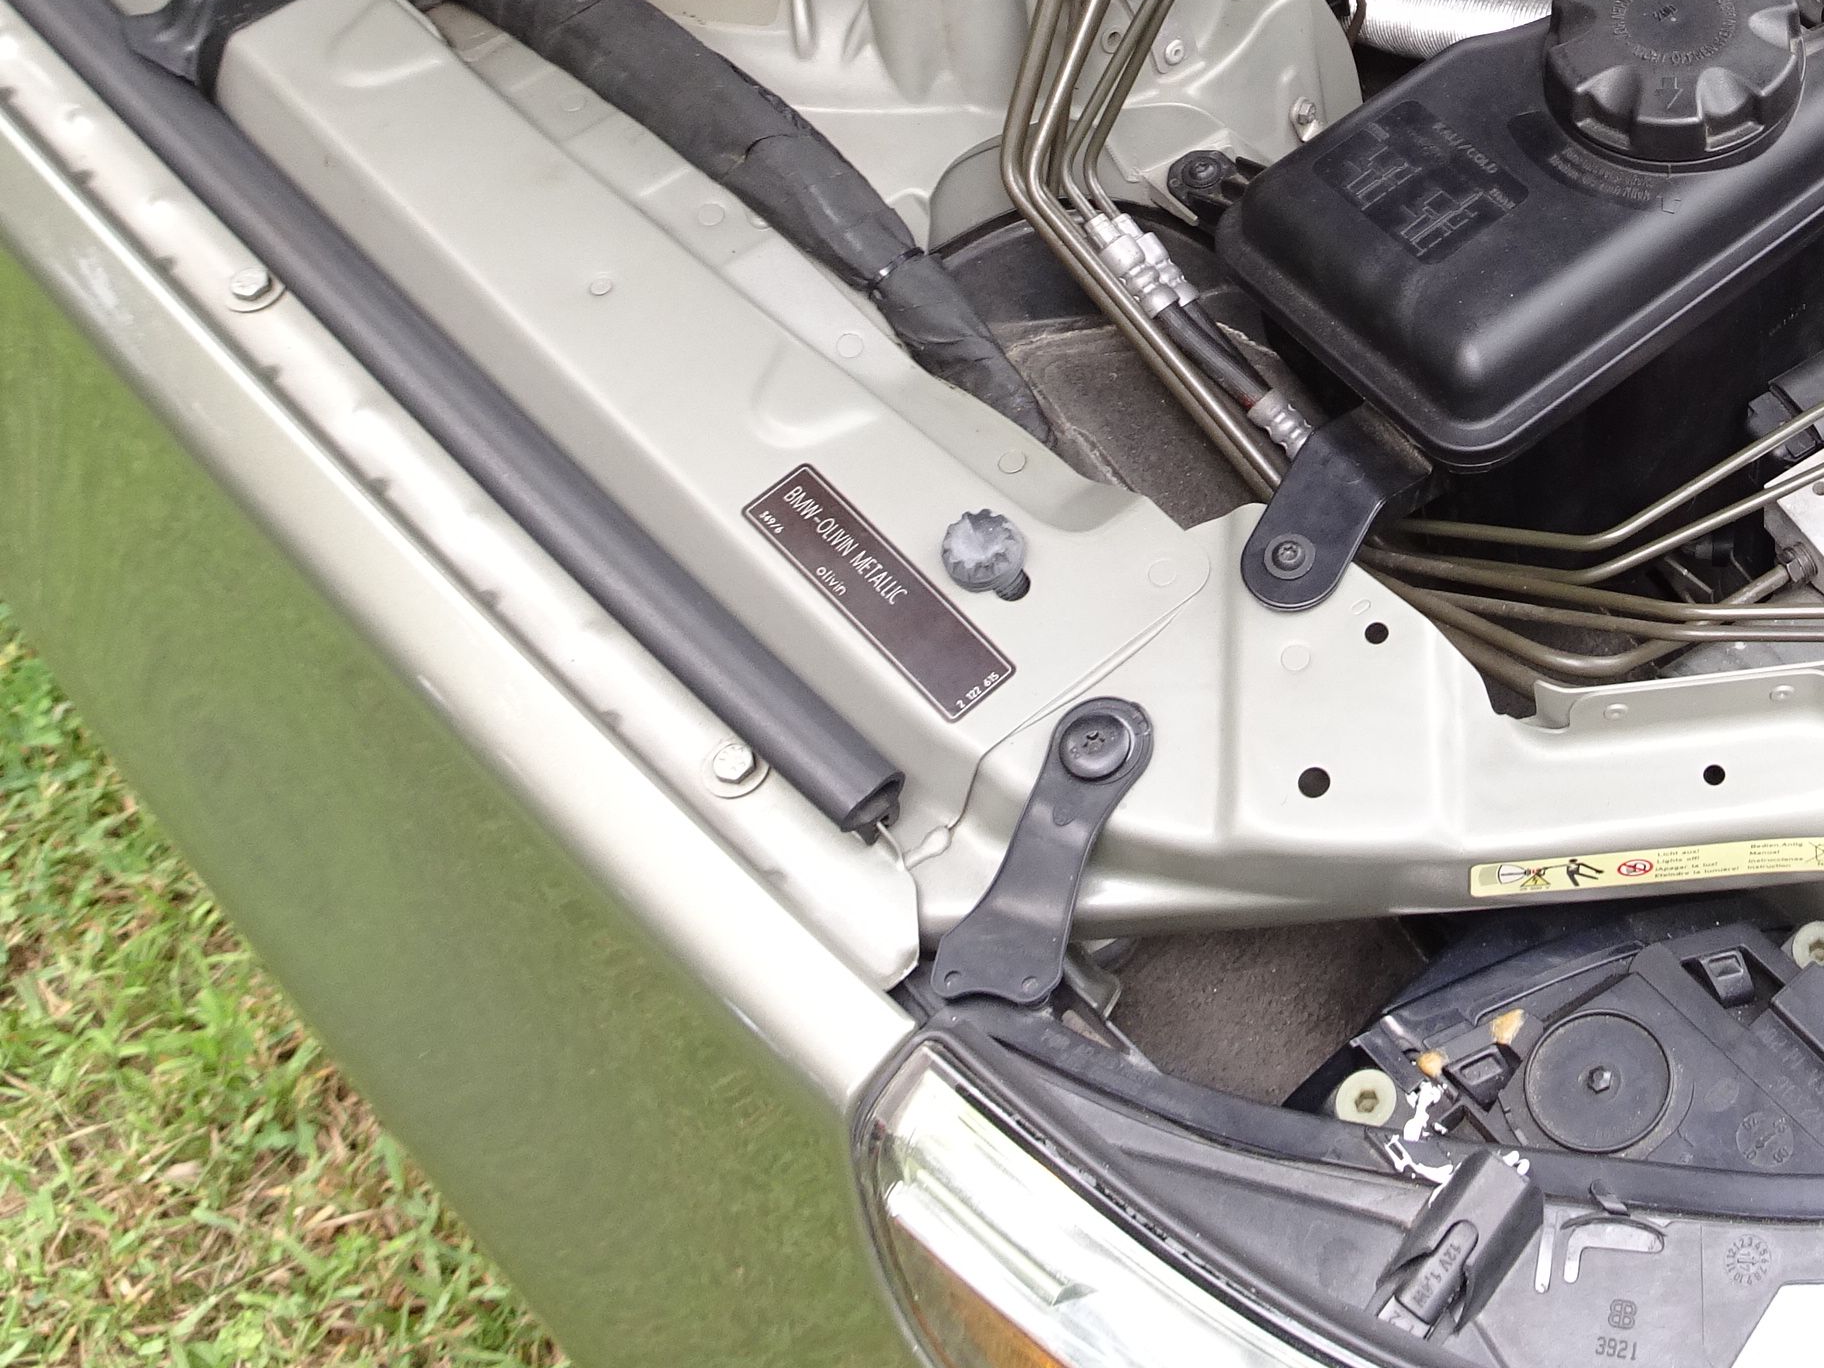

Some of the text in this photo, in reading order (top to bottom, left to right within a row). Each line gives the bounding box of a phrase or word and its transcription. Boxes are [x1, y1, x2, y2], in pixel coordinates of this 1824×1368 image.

[783, 485, 908, 605] BMW-OLIVIN METALLIC
[816, 566, 847, 596] olivin
[956, 699, 966, 709] 2
[1594, 1335, 1638, 1361] 3921
